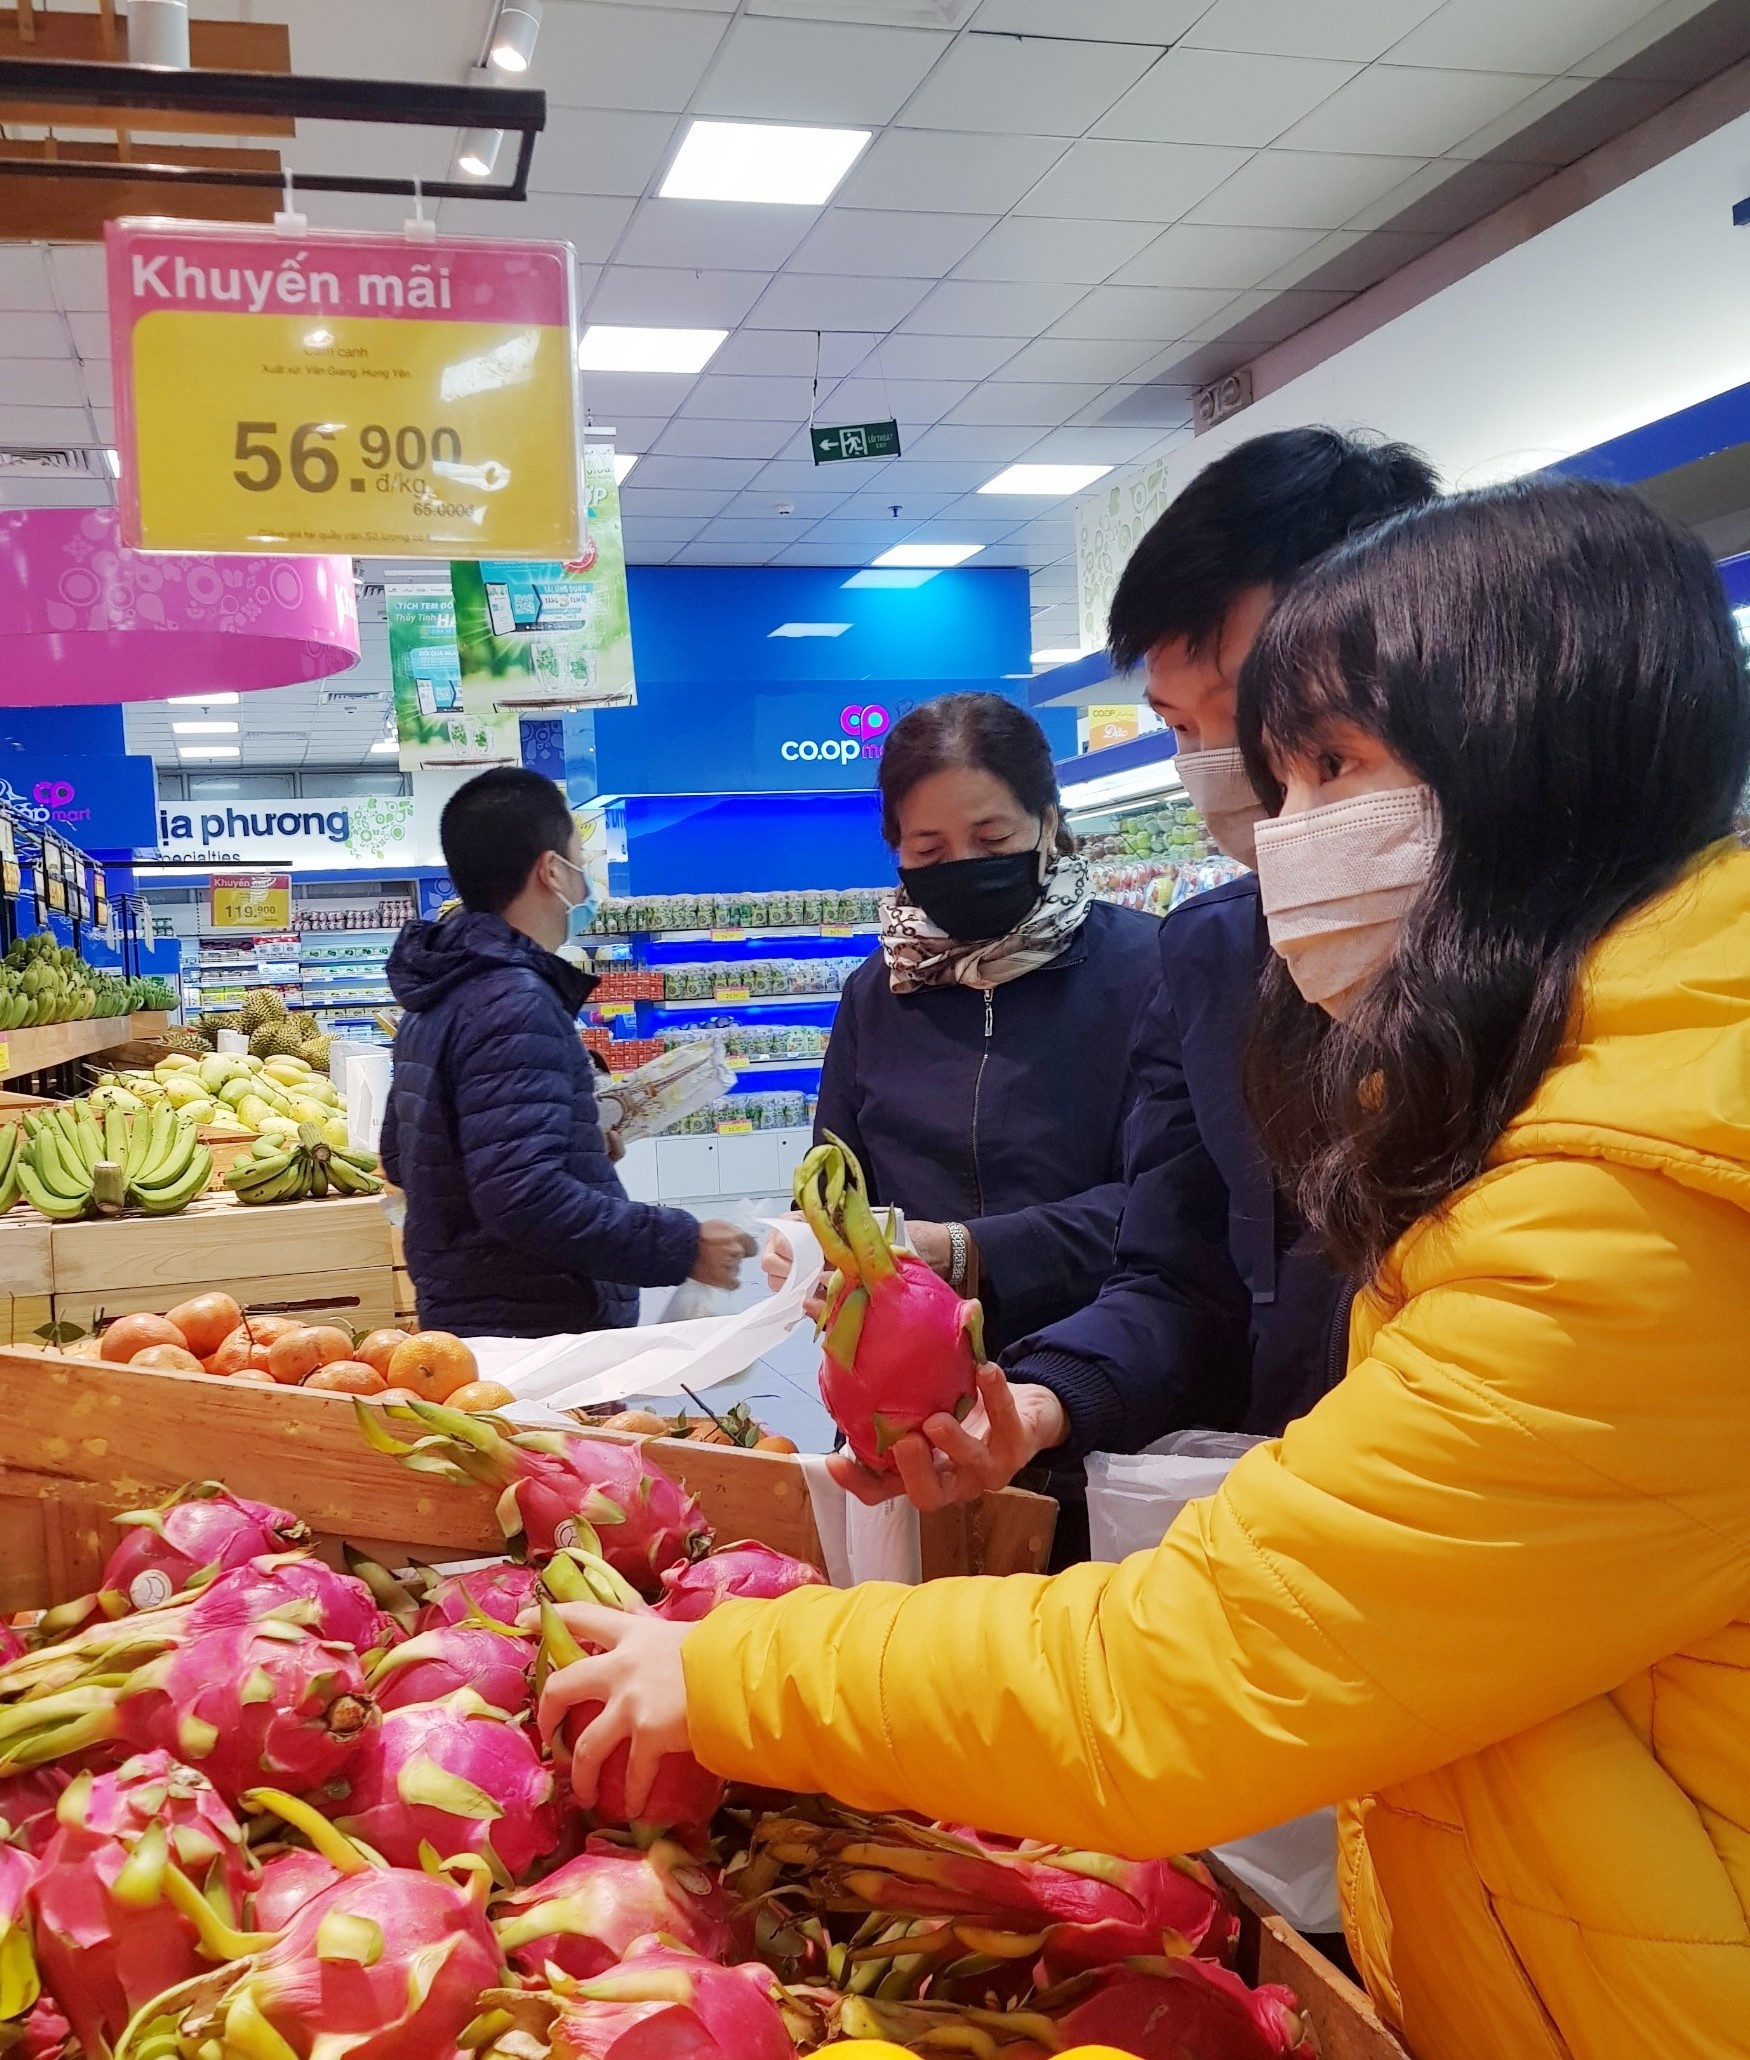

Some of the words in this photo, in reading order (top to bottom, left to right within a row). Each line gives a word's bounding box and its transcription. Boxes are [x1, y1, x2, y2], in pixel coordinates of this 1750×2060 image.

[132, 251, 340, 313] Khuyến
[359, 263, 452, 308] mãi
[337, 348, 369, 358] canh
[52, 808, 91, 822] mart
[160, 809, 193, 846] ịa
[201, 807, 350, 846] phương
[214, 877, 250, 888] Khuyến
